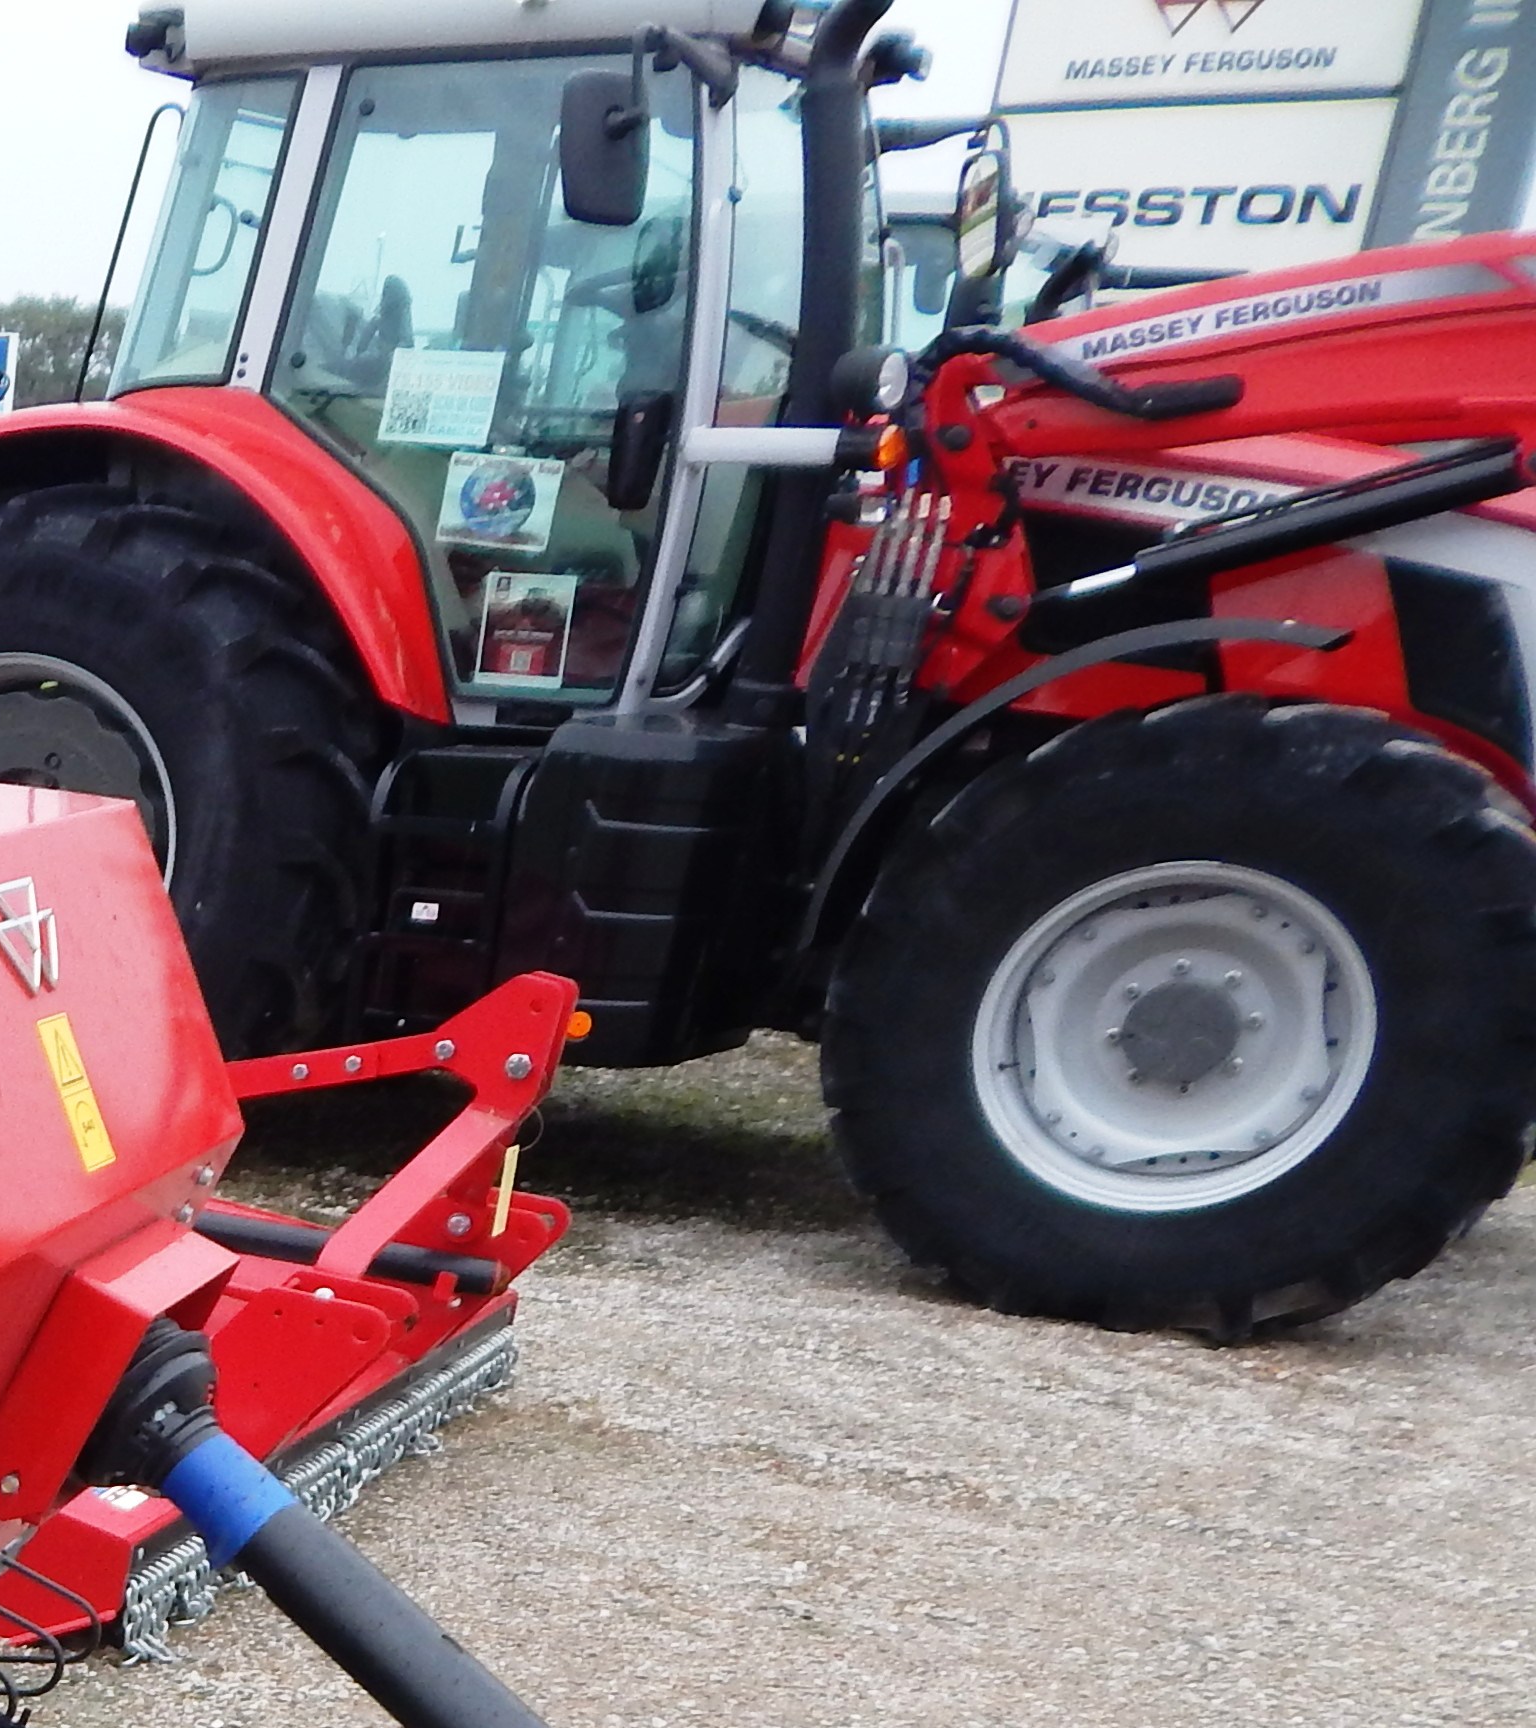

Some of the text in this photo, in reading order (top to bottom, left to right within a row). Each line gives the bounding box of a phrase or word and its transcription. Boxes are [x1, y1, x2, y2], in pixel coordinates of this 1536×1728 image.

[1065, 47, 1338, 80] MASSEY FERGUSON
[1027, 184, 1363, 227] ESSTON
[1082, 281, 1383, 360] MASSEY FERGUSON
